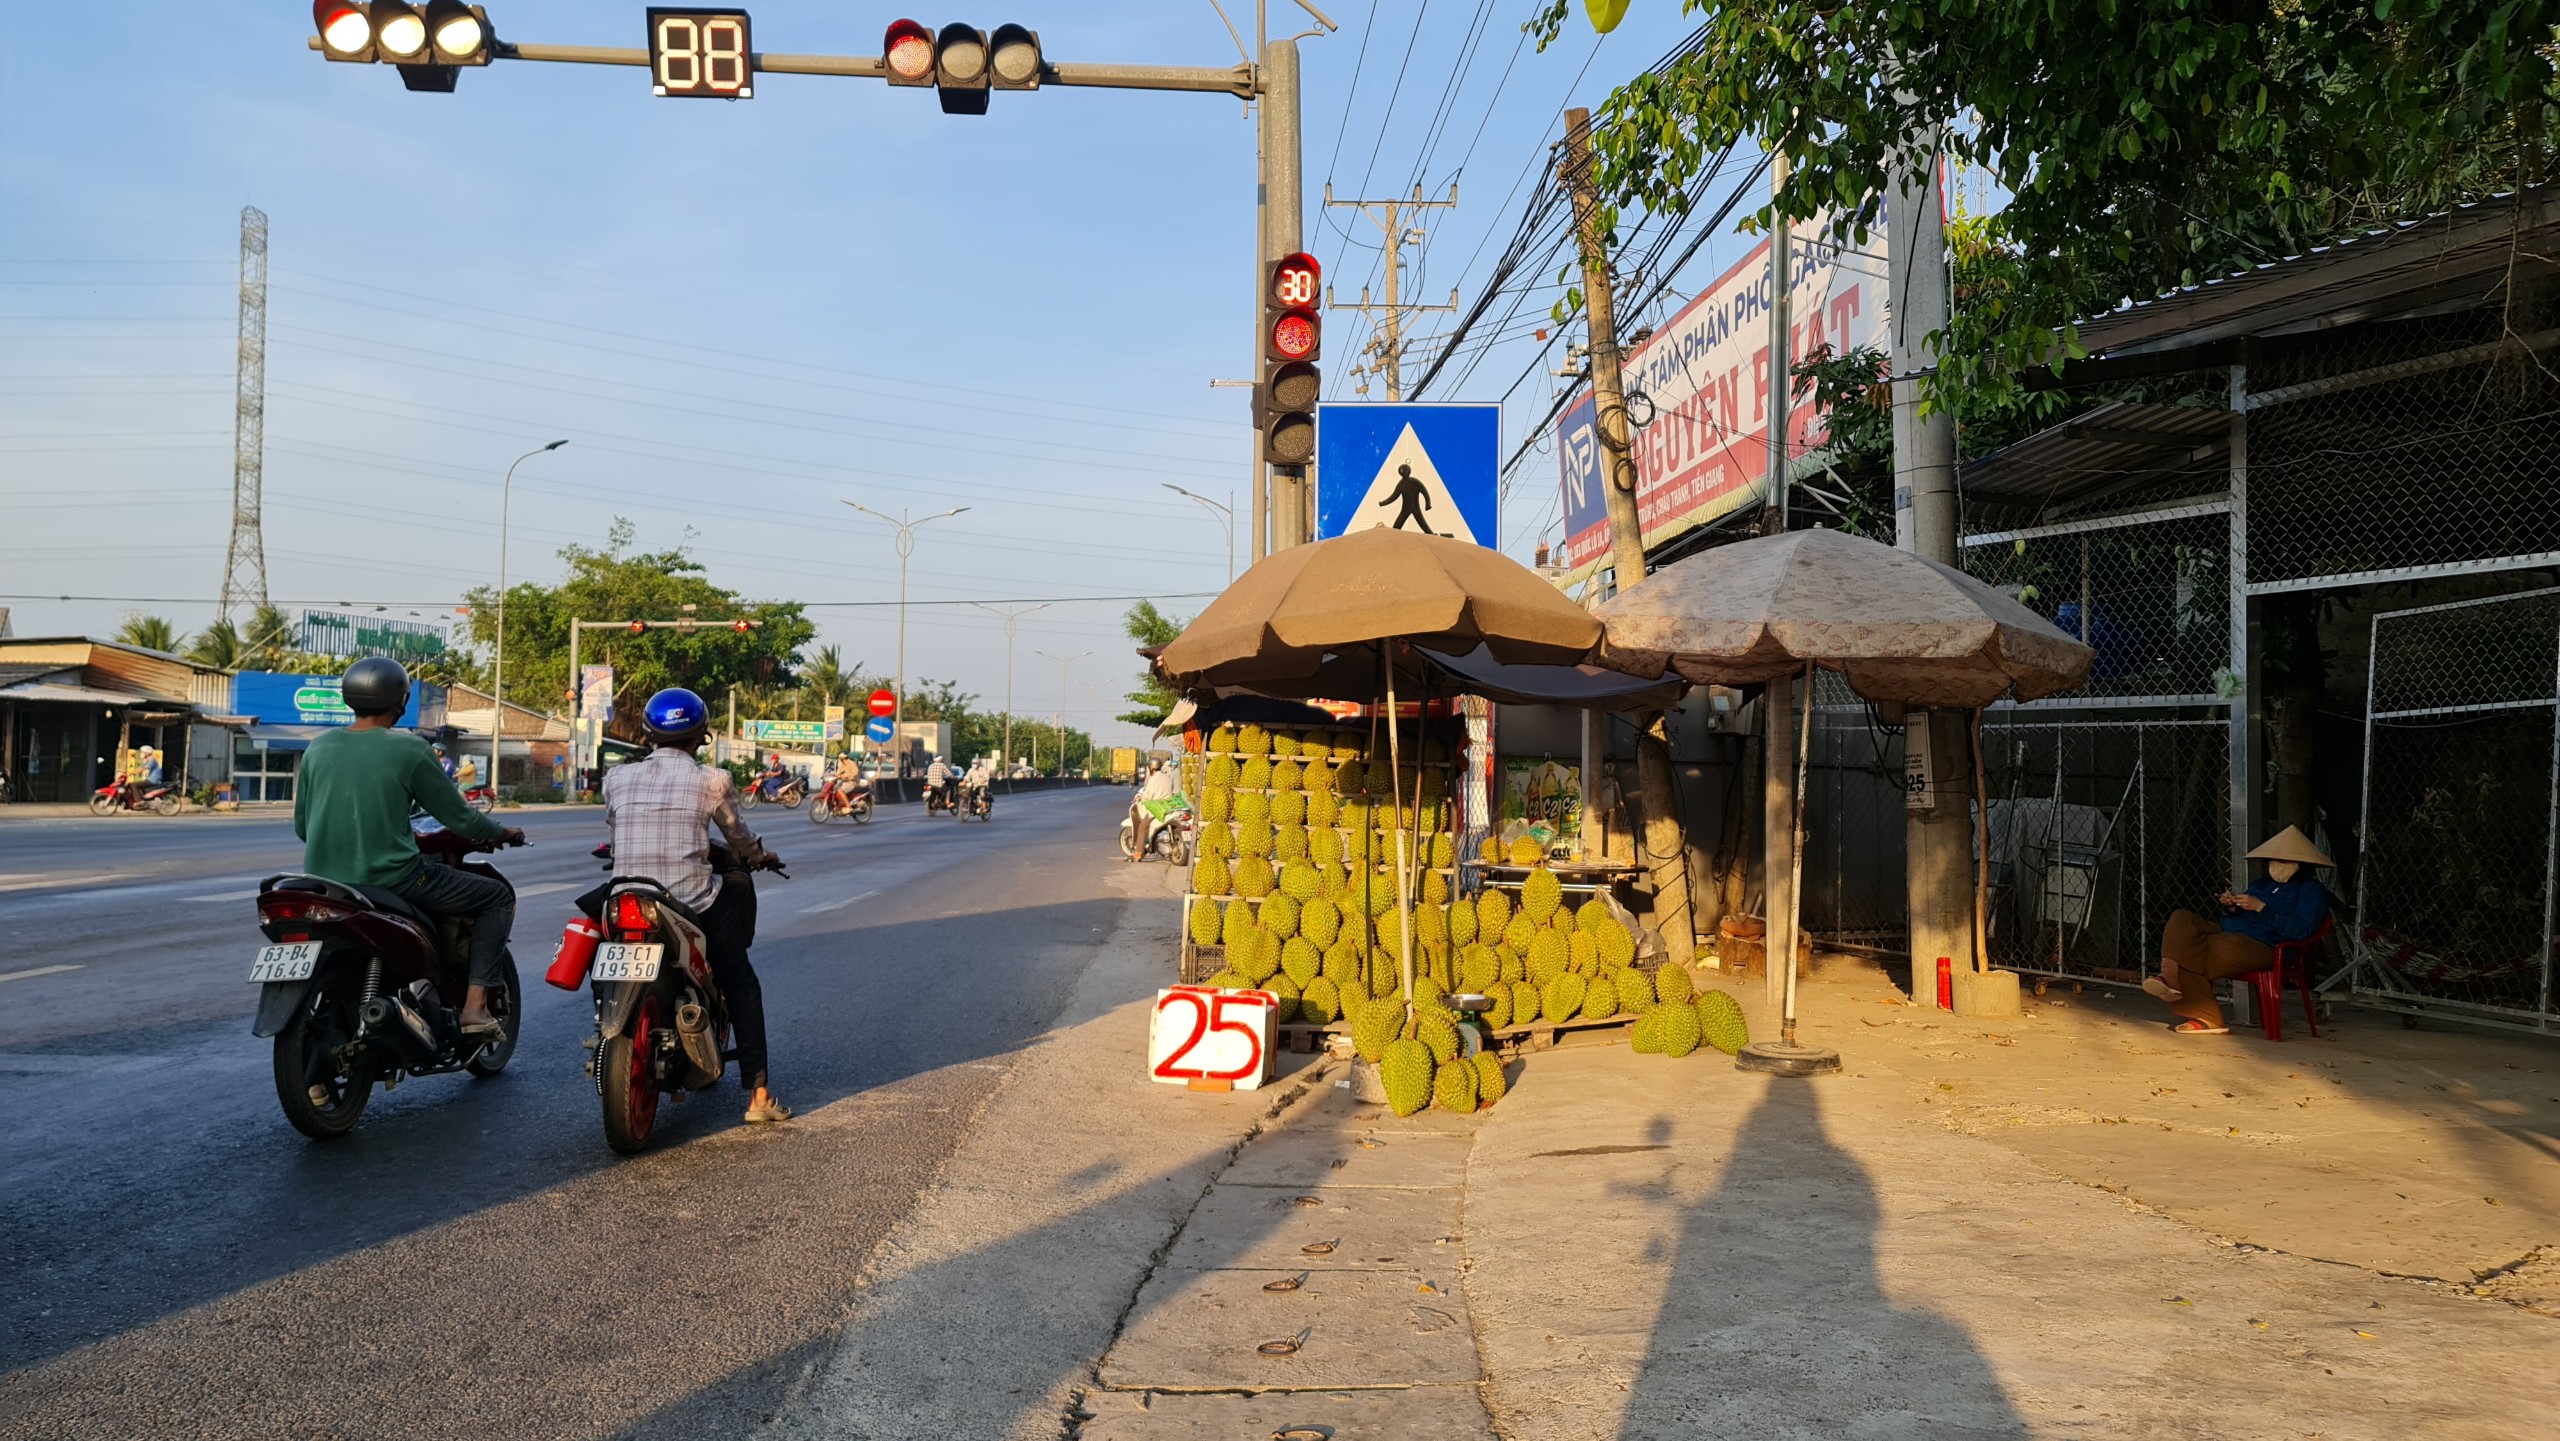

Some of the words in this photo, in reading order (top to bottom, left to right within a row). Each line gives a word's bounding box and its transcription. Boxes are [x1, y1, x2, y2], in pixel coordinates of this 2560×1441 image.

[658, 18, 744, 90] 88
[1283, 269, 1312, 302] 30
[1650, 341, 1681, 393] TÂM
[1684, 303, 1729, 366] PHÂN
[1905, 773, 1926, 793] 25
[1529, 801, 1540, 817] C2
[1543, 798, 1560, 818] C2
[1562, 796, 1578, 814] C2
[263, 944, 310, 962] 63-B4
[606, 945, 653, 962] 63-C1
[251, 961, 312, 981] 716.49
[599, 962, 656, 978] 195.50
[1154, 991, 1262, 1081] 25
